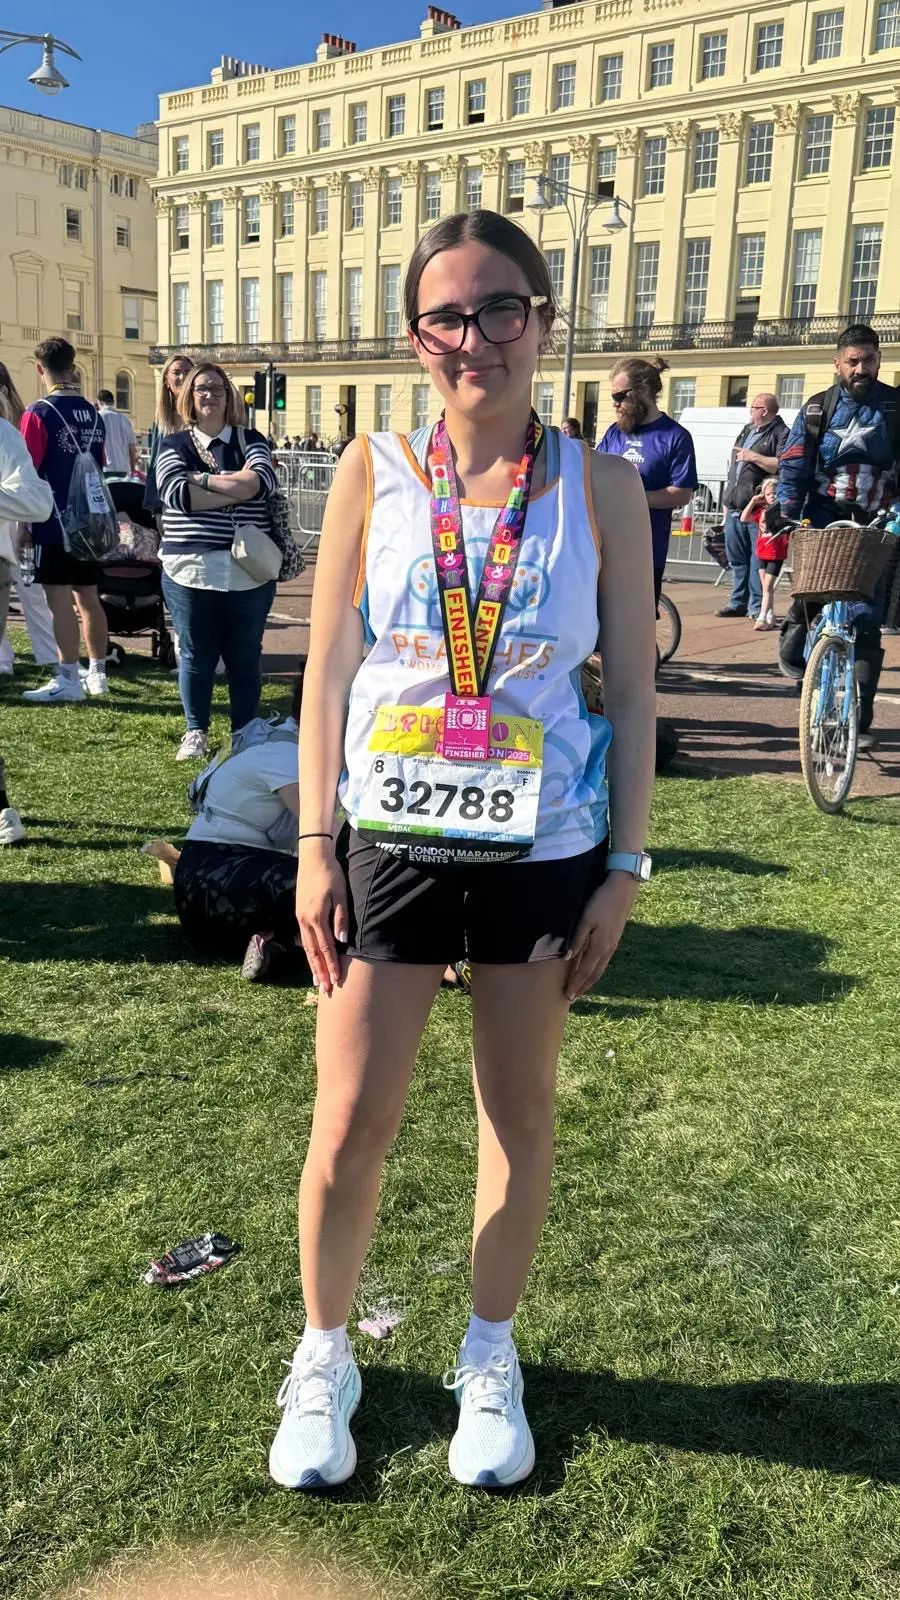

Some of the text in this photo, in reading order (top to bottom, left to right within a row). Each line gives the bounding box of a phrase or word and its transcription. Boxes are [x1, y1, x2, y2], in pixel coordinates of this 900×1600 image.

[72, 409, 92, 422] KIM
[447, 592, 474, 696] FINISHER
[475, 605, 497, 672] FINIS
[391, 633, 555, 669] PEAHES
[382, 711, 531, 744] BRION
[444, 749, 485, 759] FINISHER
[507, 751, 529, 761] 2025
[374, 760, 384, 773] 8
[522, 778, 529, 786] F
[380, 777, 515, 823] 32788
[408, 845, 455, 857] LONDON
[408, 854, 449, 864] EVENTS
